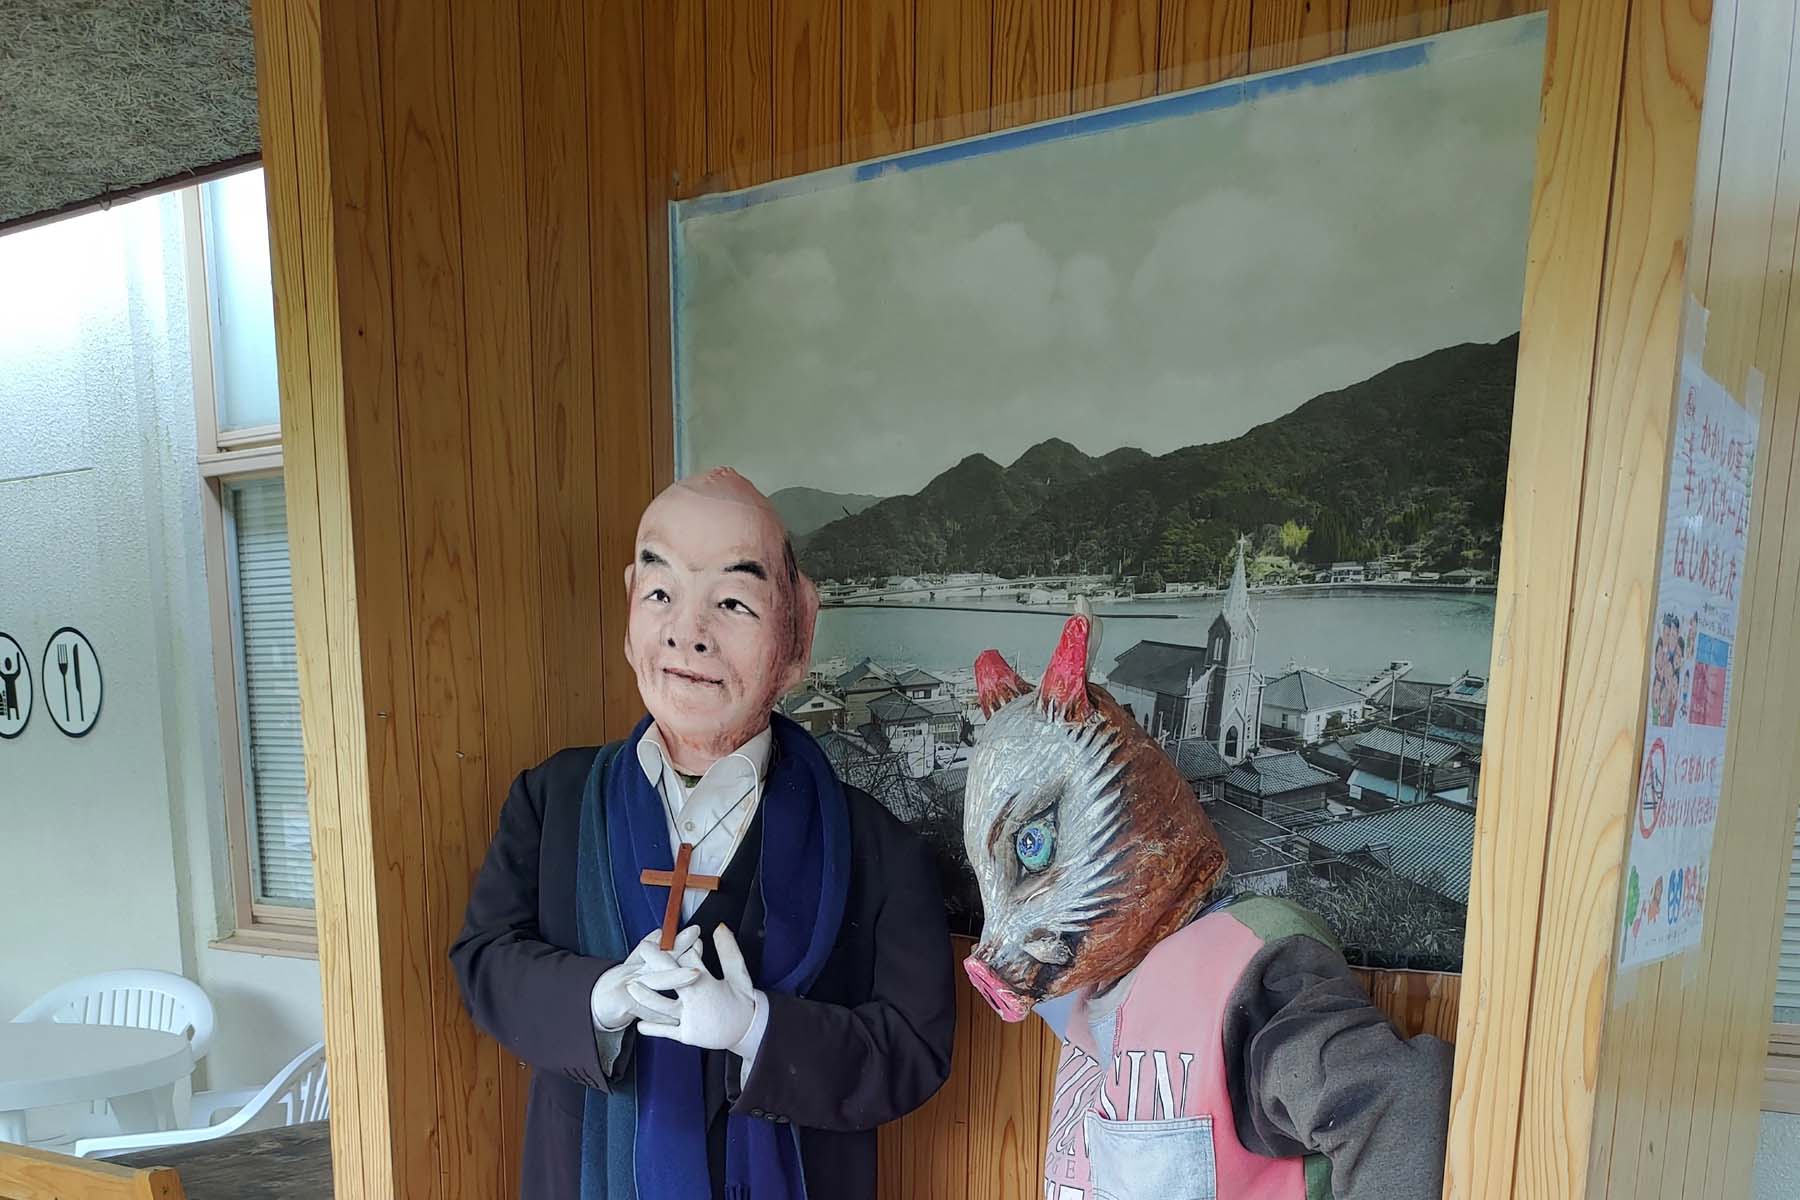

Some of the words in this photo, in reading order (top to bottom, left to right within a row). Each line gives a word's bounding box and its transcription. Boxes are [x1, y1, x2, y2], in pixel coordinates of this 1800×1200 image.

[1674, 528, 1737, 600] はじめました
